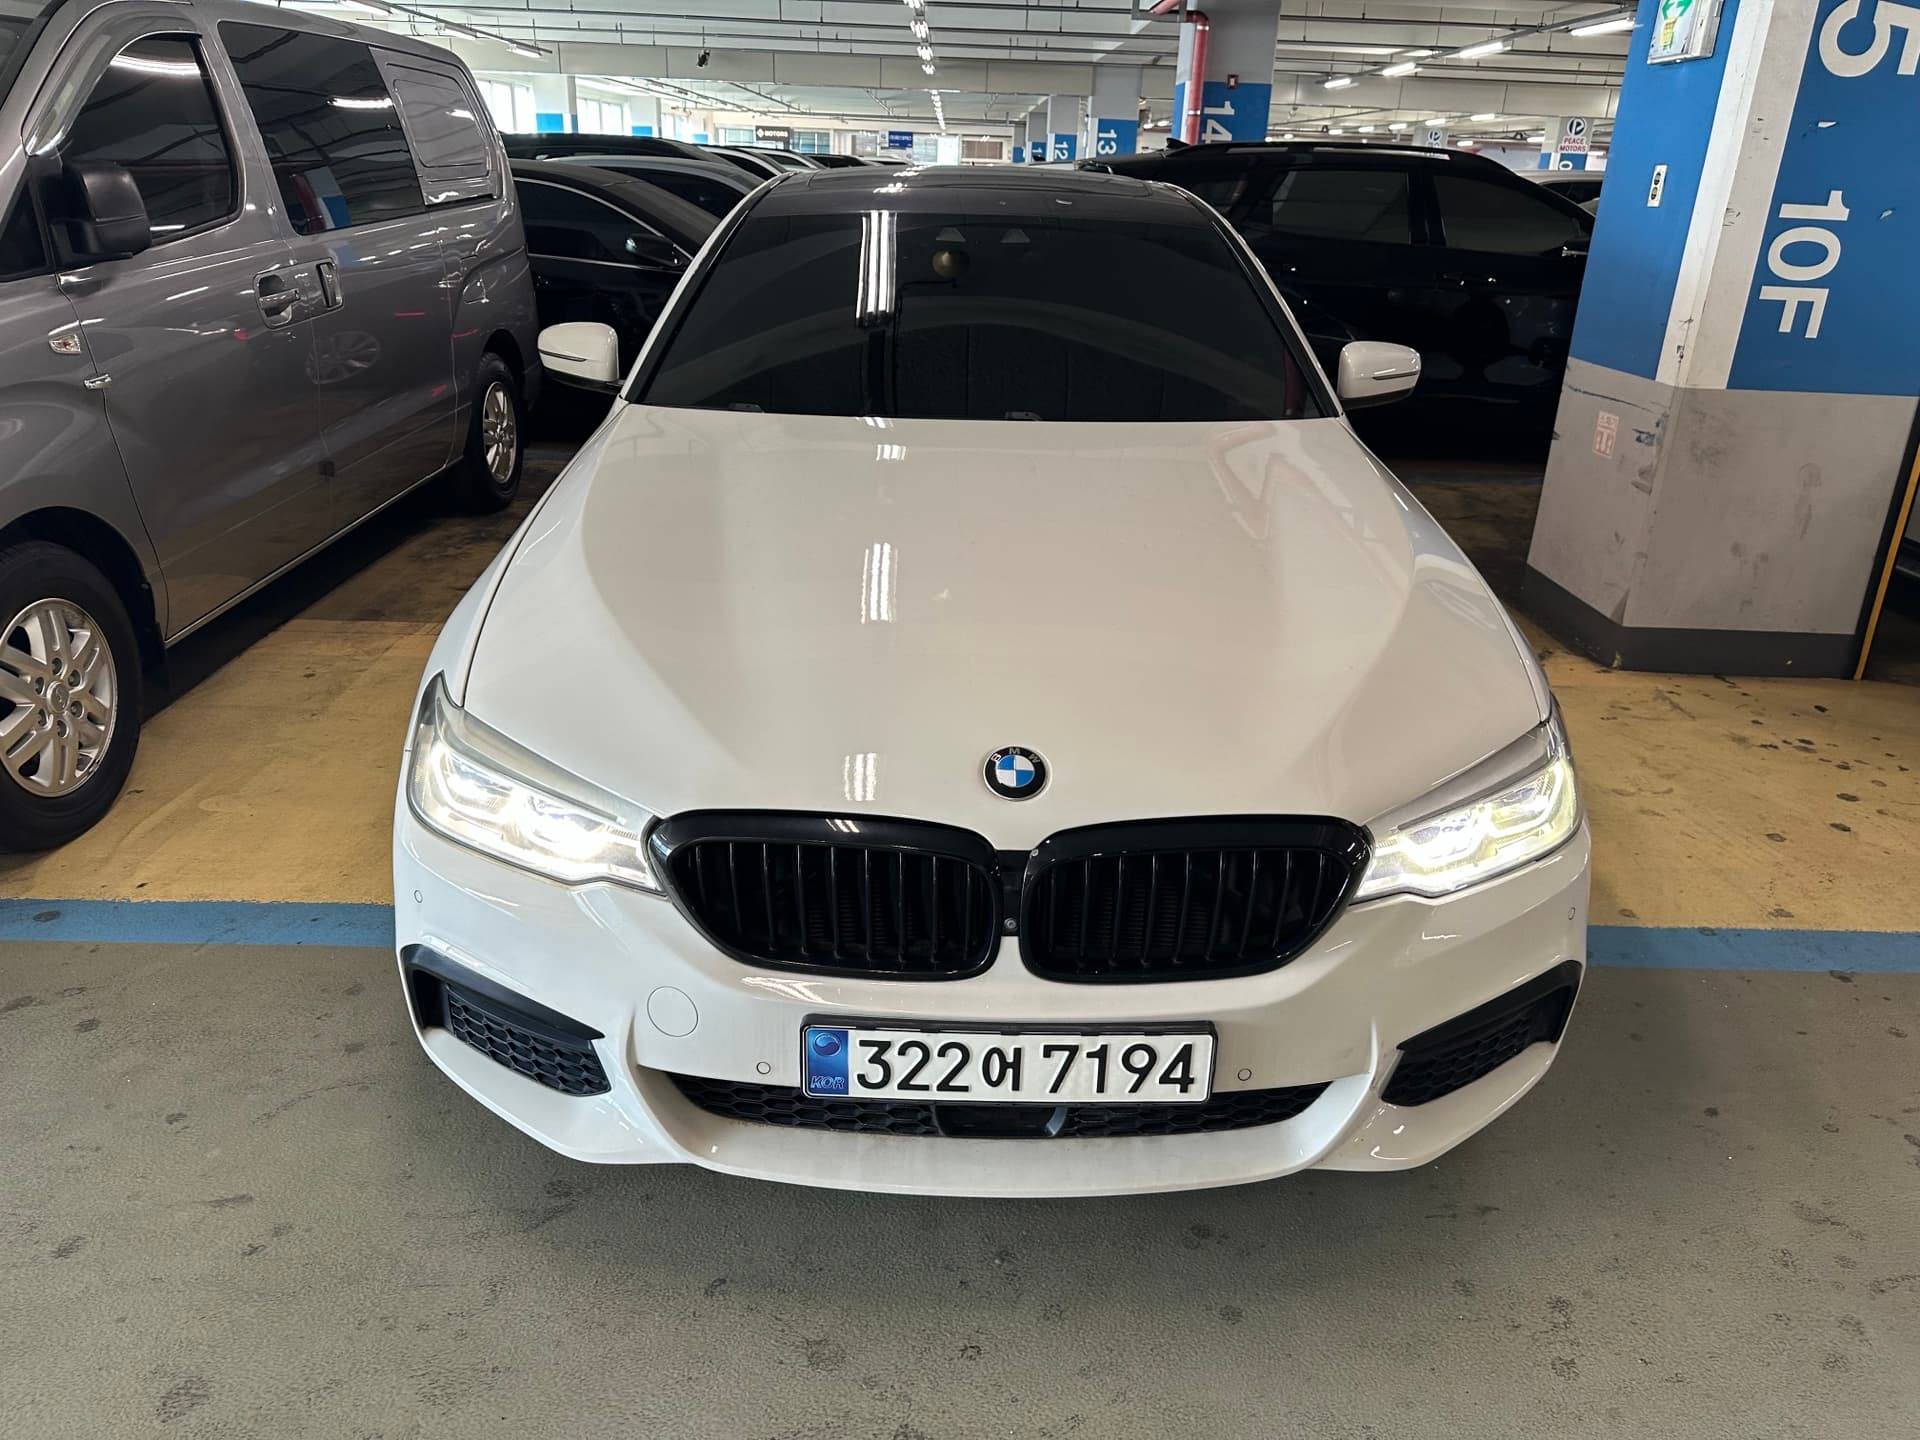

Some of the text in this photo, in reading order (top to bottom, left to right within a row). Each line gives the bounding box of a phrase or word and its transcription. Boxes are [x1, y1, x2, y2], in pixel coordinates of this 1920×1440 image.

[1201, 100, 1235, 142] 14
[1054, 141, 1068, 160] 12
[1097, 129, 1117, 155] 13
[1558, 144, 1587, 152] MOTORS
[1563, 137, 1585, 145] PEACE
[1759, 190, 1850, 338] 10F
[991, 747, 1041, 763] BMW
[856, 1039, 1195, 1094] 322어 7194
[810, 1075, 845, 1089] KOR
